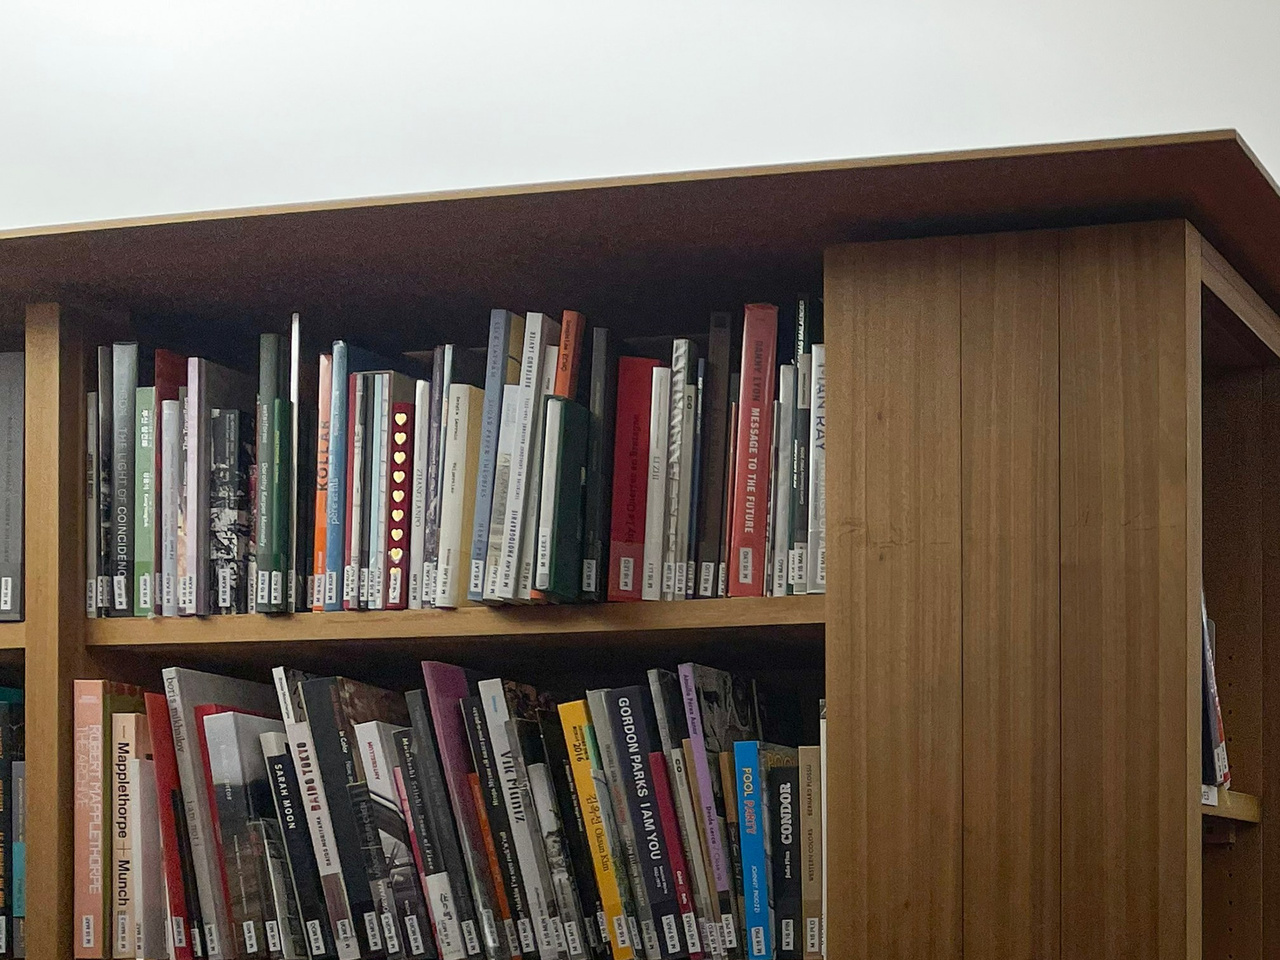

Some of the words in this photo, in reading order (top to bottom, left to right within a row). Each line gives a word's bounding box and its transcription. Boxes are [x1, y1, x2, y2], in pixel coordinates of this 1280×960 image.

[752, 377, 762, 402] LYON
[749, 407, 760, 454] MESSAGE
[815, 416, 826, 448] RAY
[316, 420, 329, 491] KOLLAR
[748, 458, 758, 470] TO
[746, 474, 756, 492] THE
[744, 496, 756, 534] FUTURE
[117, 506, 128, 580] COINCIDENC
[507, 510, 518, 558] PHOTOGRAPHIE
[166, 676, 177, 704] boris
[170, 708, 185, 752] mikhailov
[618, 697, 638, 753] GORDON
[88, 724, 101, 780] ROBERT
[296, 742, 312, 776] TOKYO
[573, 742, 585, 762] 2016
[116, 742, 130, 838] Mapplethorpe
[630, 755, 648, 798] PARKS
[742, 768, 754, 797] POOL
[274, 764, 286, 796] SARAH
[283, 800, 296, 830] MOON
[780, 782, 792, 844] CONDOR
[641, 808, 656, 832] AM
[706, 806, 714, 825] Desde
[744, 800, 757, 834] PARTY
[88, 782, 101, 894] MAPPLETHORPE
[594, 828, 606, 854] Oksun
[646, 834, 662, 860] YOU
[598, 855, 610, 872] Kim
[118, 860, 130, 906] Munch
